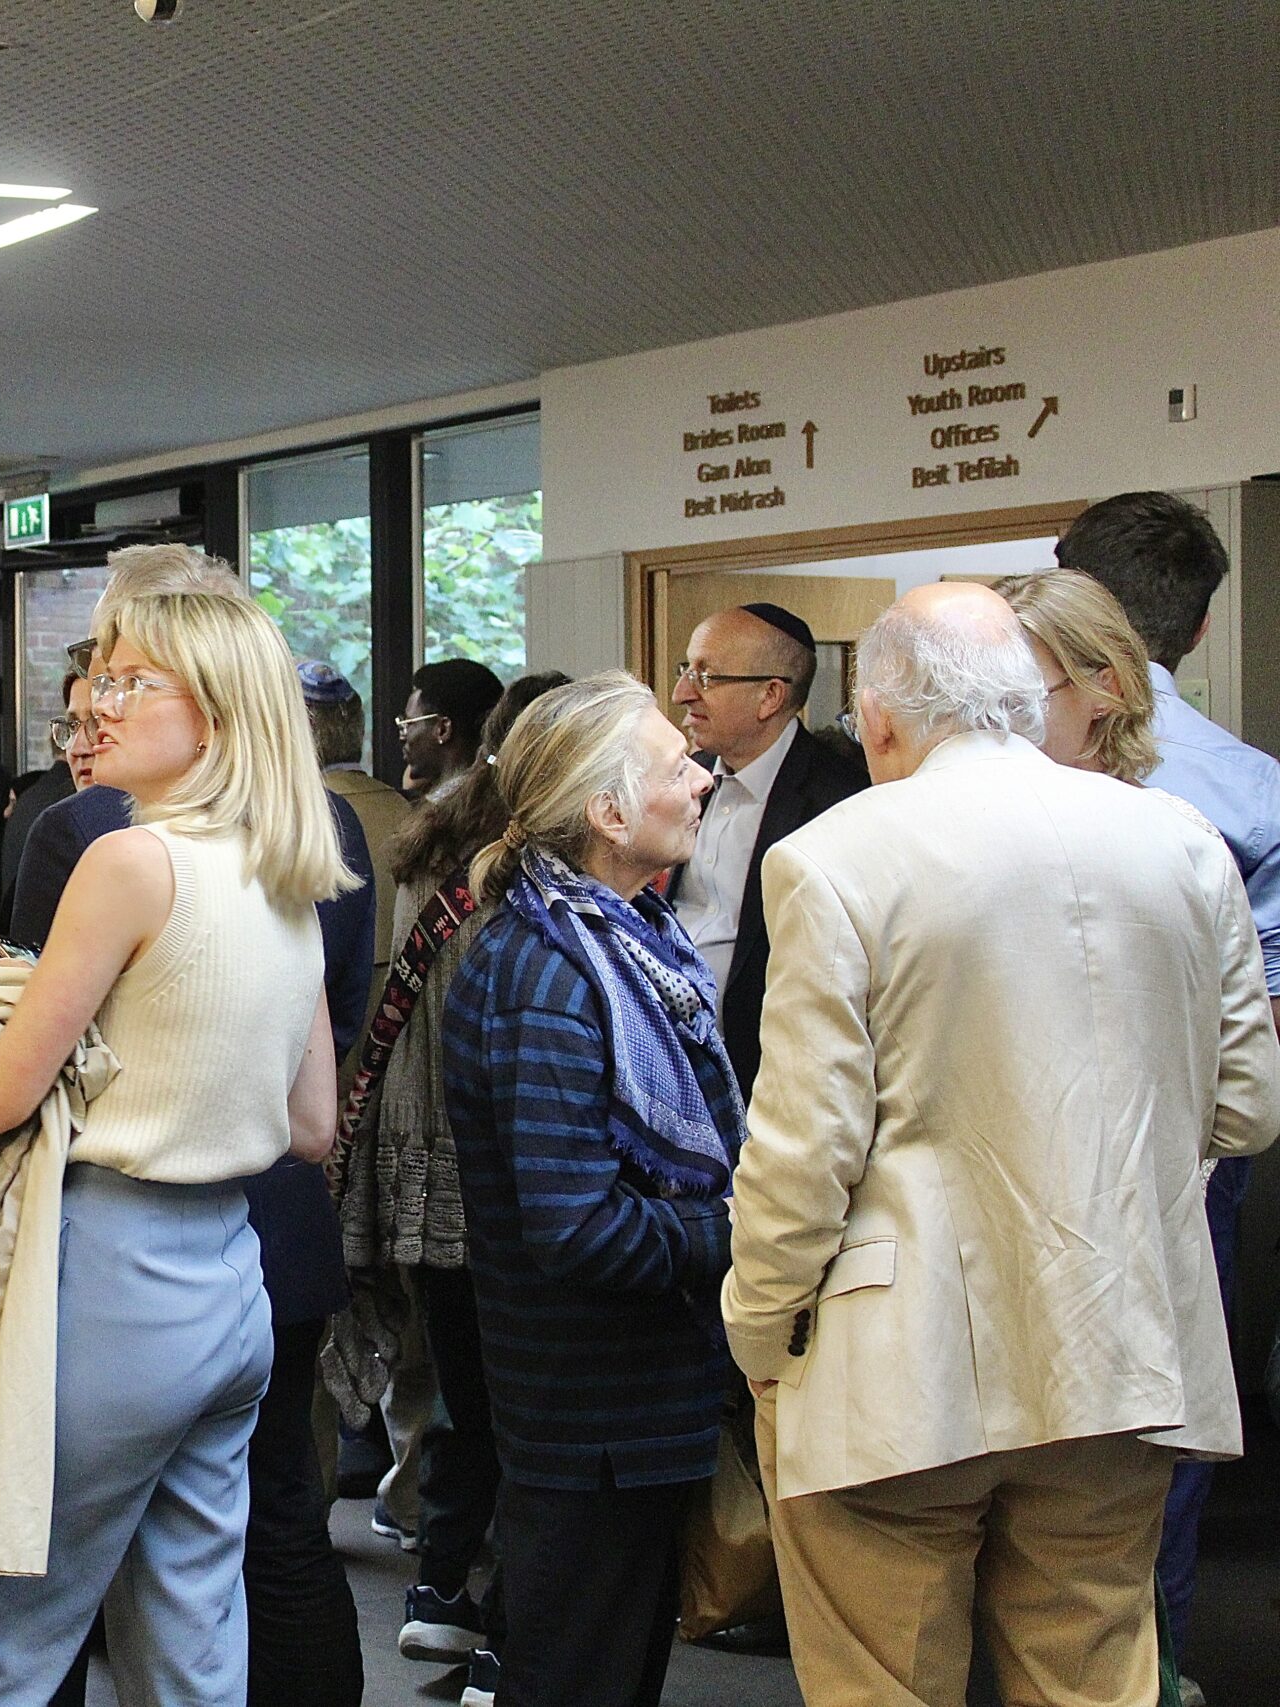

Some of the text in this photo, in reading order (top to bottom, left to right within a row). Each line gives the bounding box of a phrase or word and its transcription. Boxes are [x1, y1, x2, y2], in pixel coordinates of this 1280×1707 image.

[924, 345, 1006, 379] Upstairs
[707, 390, 761, 414] Toilets
[907, 382, 1026, 416] Youth Room
[683, 421, 786, 451] Brides Room
[930, 423, 1000, 449] Offices
[697, 456, 772, 483] Gan Alon
[912, 453, 1020, 489] Beit Tefilah
[684, 485, 786, 518] Beit Midrash
